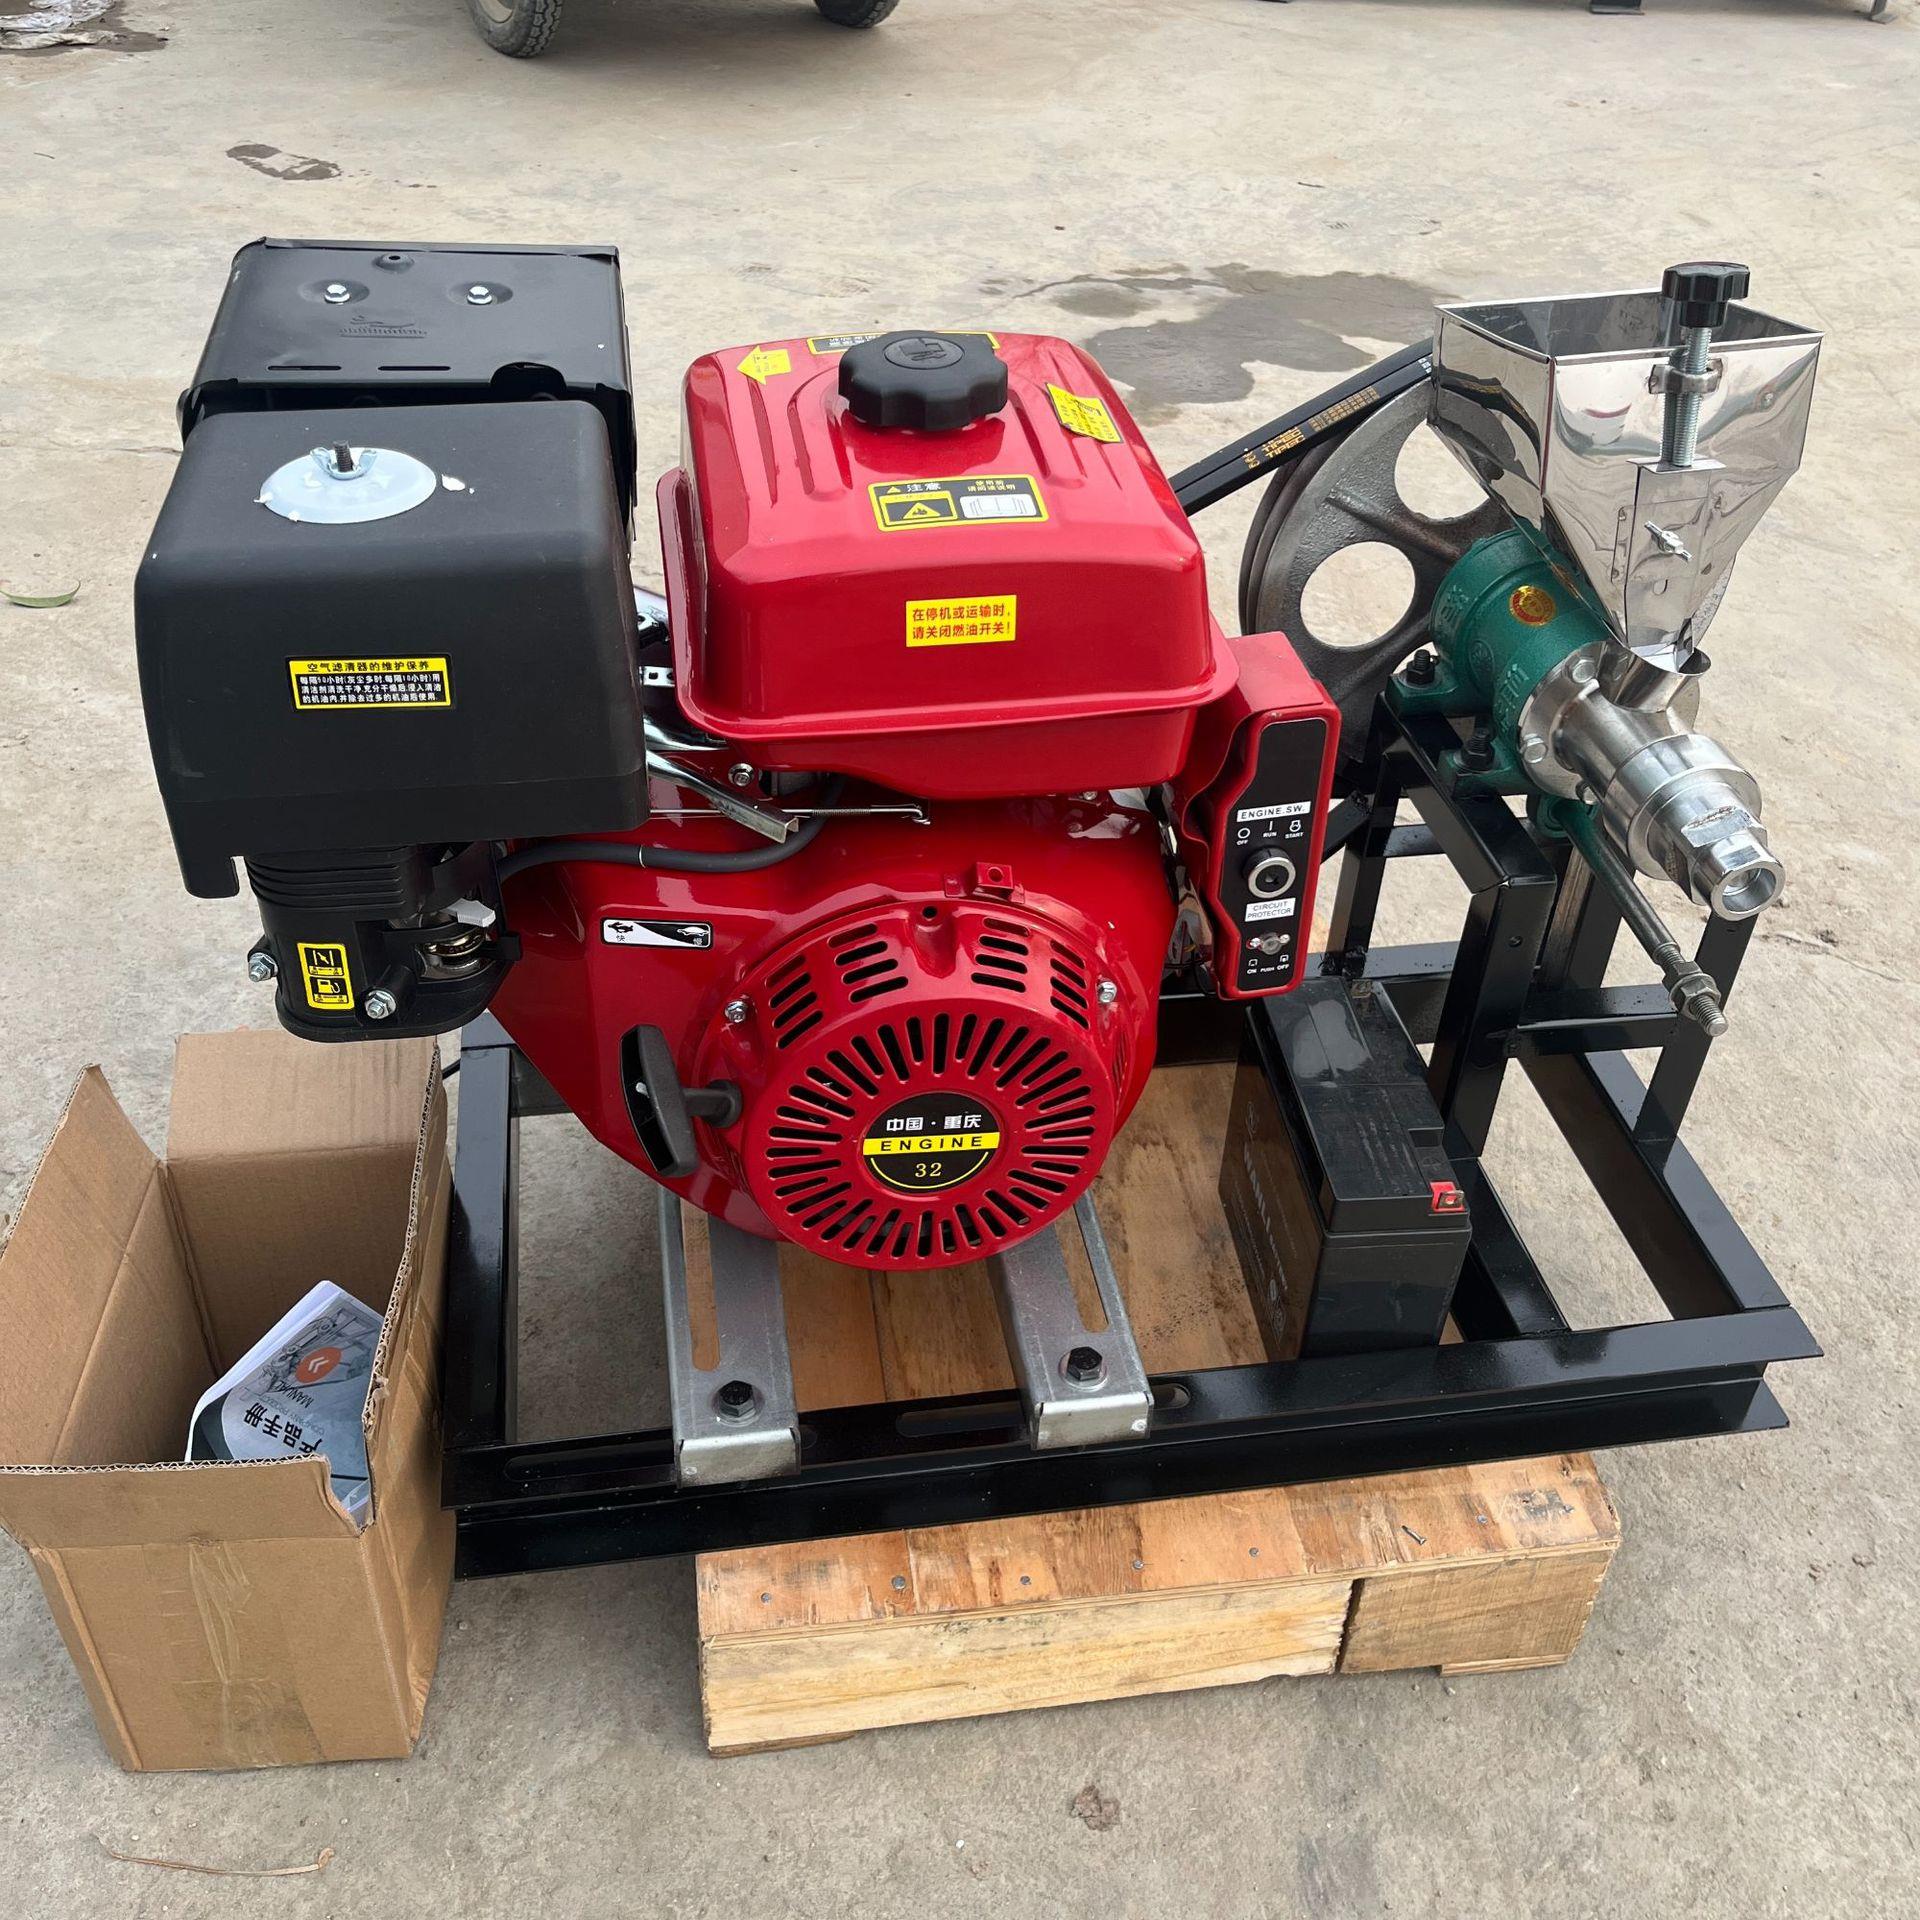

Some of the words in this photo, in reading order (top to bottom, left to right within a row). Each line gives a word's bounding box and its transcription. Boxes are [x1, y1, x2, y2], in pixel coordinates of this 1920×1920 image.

[906, 482, 942, 492] 注意
[307, 661, 429, 672] 空气滤清器的维护保养
[1253, 901, 1288, 912] CIRCUIT
[1247, 907, 1292, 919] PROTECTOR
[1276, 963, 1290, 971] OFF
[880, 1136, 983, 1152] ENGINE
[915, 1162, 942, 1178] 32
[275, 1380, 315, 1408] MANUAL
